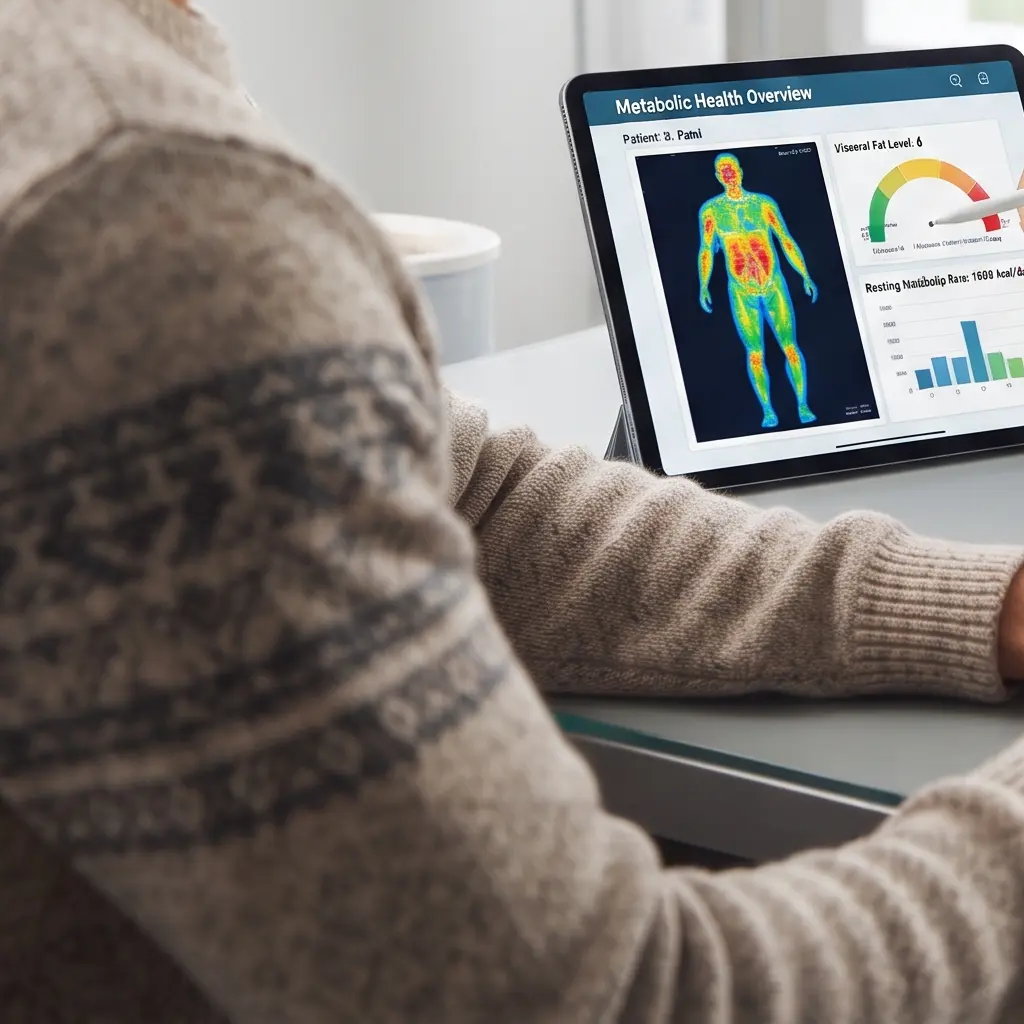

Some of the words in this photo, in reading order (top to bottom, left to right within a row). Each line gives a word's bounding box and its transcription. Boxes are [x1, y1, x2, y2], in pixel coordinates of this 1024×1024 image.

[615, 94, 692, 115] Metabolic
[694, 89, 743, 109] Health
[747, 85, 812, 104] Overview
[623, 132, 661, 144] Patient:
[872, 139, 887, 150] Fat
[916, 136, 923, 147] 6
[865, 280, 901, 294] Resting
